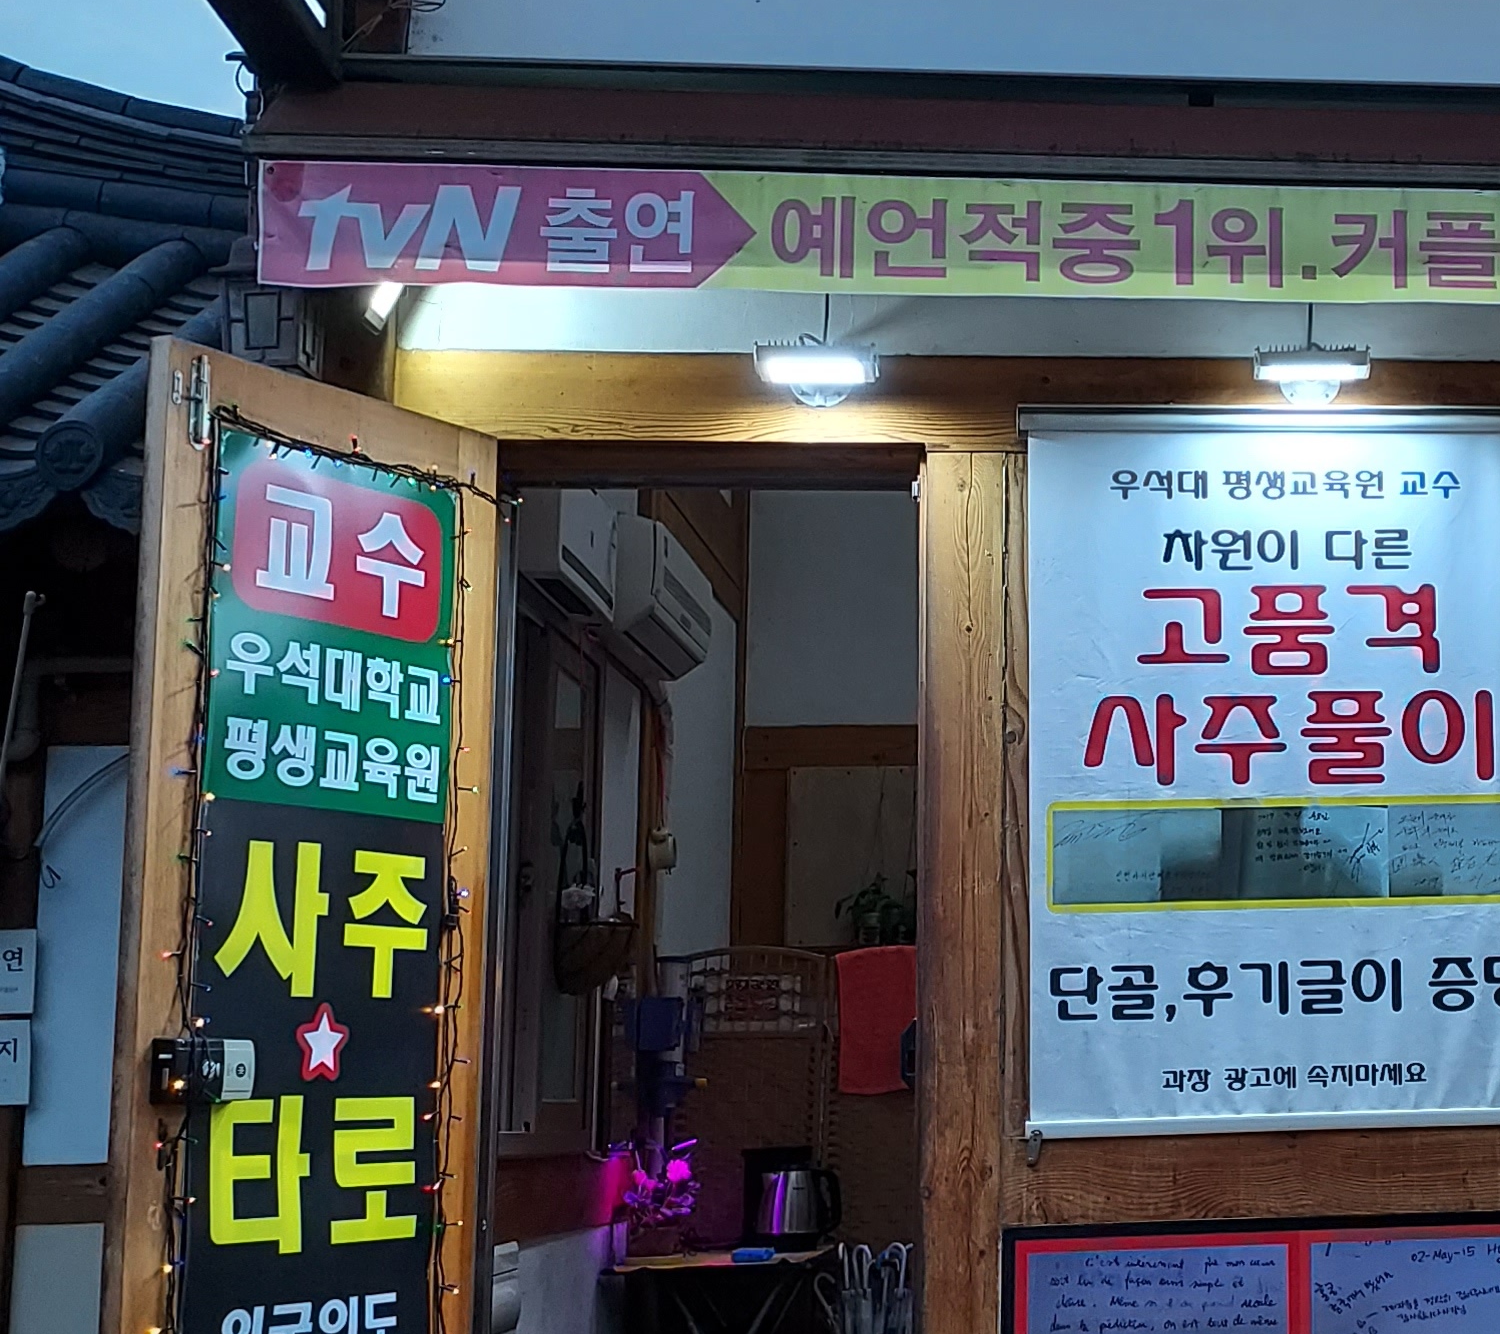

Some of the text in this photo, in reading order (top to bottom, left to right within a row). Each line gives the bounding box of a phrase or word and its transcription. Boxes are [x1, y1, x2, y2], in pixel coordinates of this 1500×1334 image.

[298, 183, 521, 272] tvN
[539, 188, 695, 273] 출연
[1109, 467, 1462, 501] 우석대 평생교육원 교수
[256, 484, 427, 620] 교수
[1161, 528, 1413, 572] 차원이 다른
[1136, 583, 1441, 677] 고품격
[225, 631, 442, 726] 우석대학교
[224, 715, 440, 804] 평생교육원
[1082, 687, 1498, 787] 사주풀이
[213, 840, 429, 999] 사주
[1160, 1060, 1429, 1095] 과장 광고에 속지마세요
[209, 1094, 418, 1255] 타로
